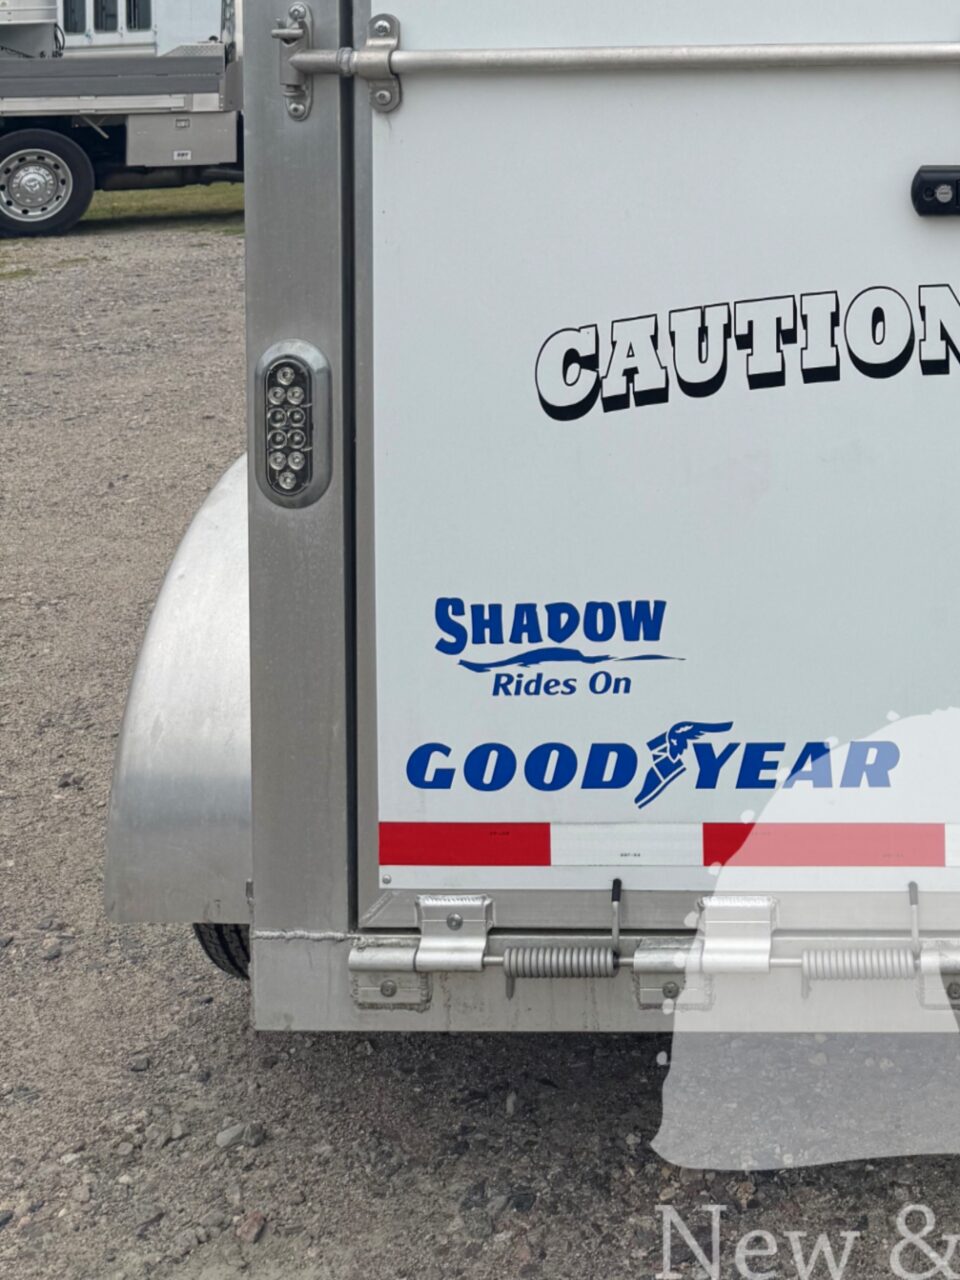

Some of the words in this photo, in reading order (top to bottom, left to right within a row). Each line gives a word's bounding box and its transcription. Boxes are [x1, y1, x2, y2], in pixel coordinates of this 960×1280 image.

[435, 597, 667, 655] SHADOW
[492, 672, 577, 696] Rides
[589, 670, 632, 695] On
[406, 740, 901, 791] GOODYEAR
